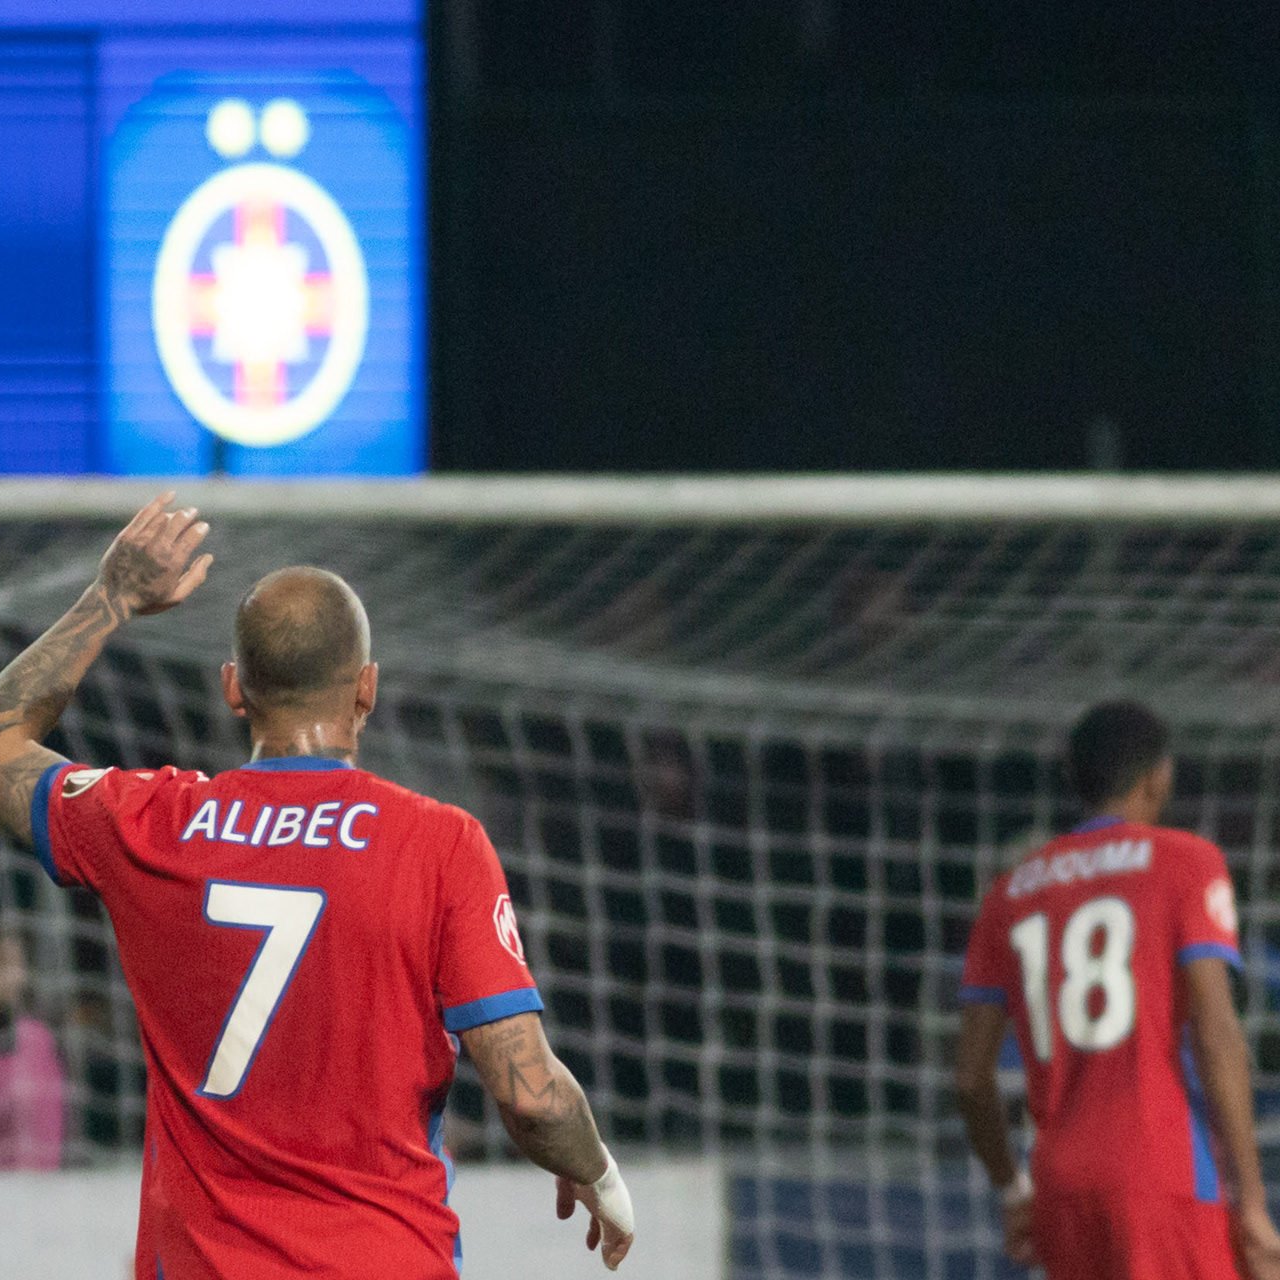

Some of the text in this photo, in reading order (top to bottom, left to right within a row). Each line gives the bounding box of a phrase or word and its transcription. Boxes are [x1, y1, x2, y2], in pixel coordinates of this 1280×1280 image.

[178, 797, 379, 850] ALIBEC
[194, 878, 328, 1100] 7
[1009, 896, 1137, 1064] 18
